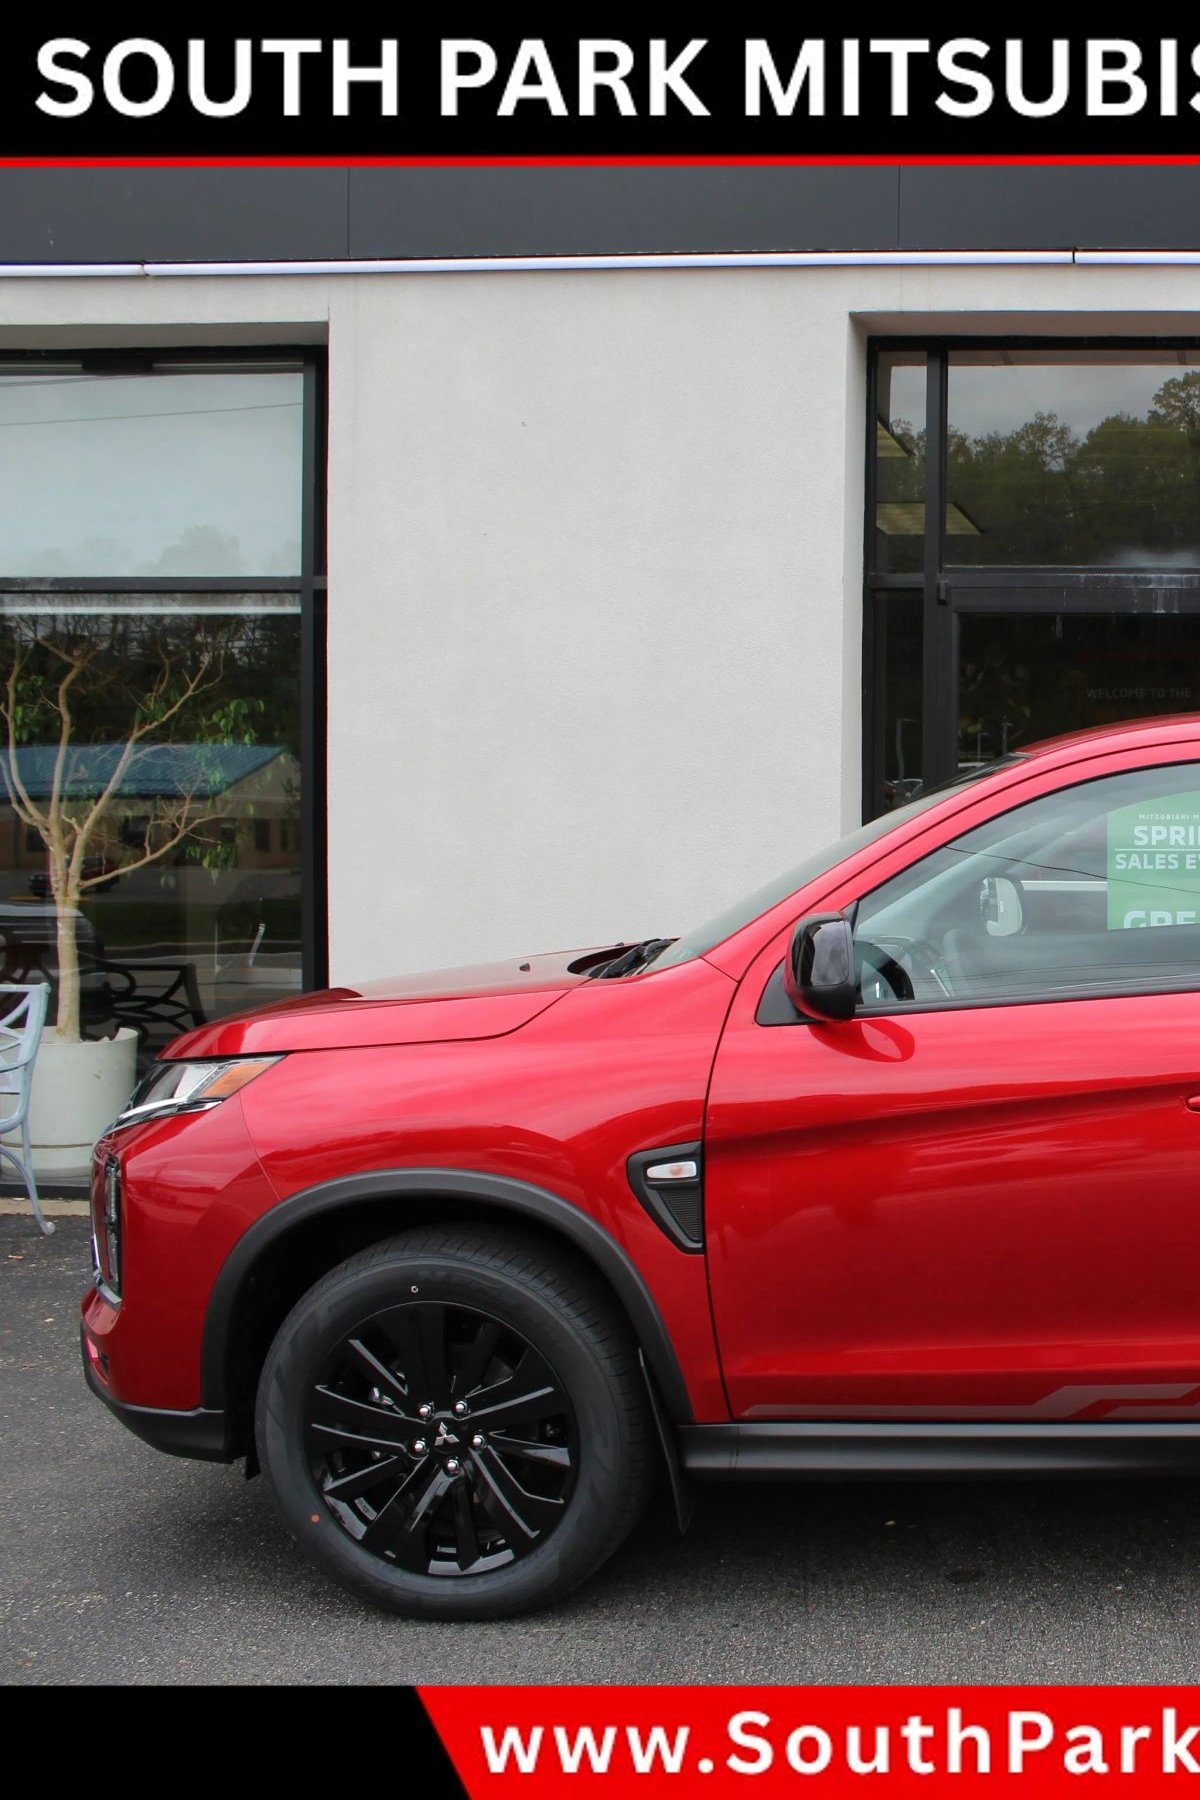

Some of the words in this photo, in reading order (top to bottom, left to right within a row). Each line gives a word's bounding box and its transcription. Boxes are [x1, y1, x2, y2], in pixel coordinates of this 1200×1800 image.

[1086, 687, 1145, 698] WELCOME
[1149, 687, 1166, 698] TO
[1169, 687, 1192, 698] THE
[1115, 853, 1179, 870] SALES
